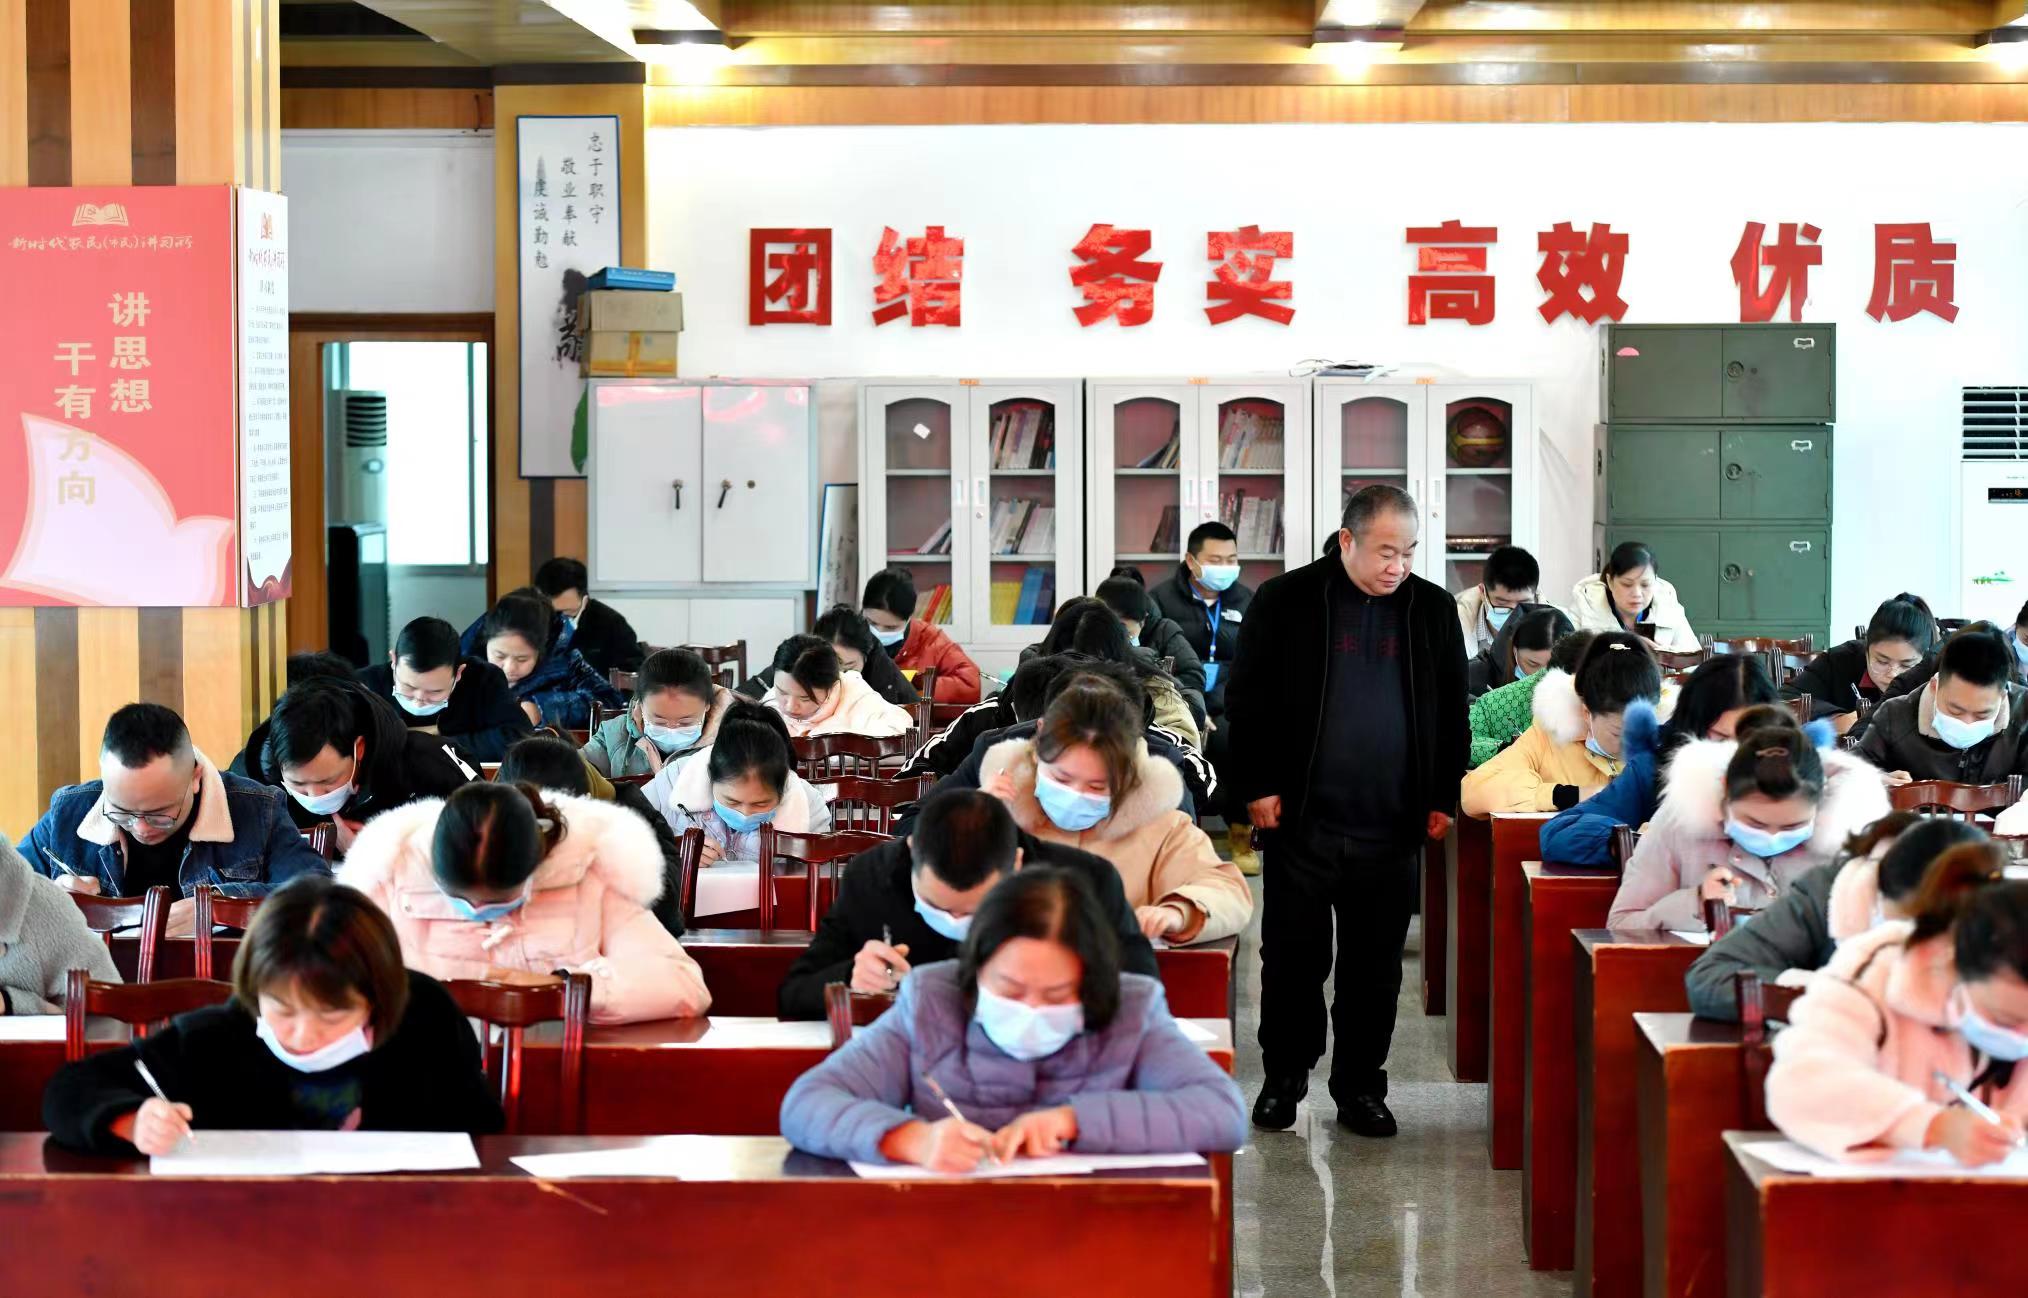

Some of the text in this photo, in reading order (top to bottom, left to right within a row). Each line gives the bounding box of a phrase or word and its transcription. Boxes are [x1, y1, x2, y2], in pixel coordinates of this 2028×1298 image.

[560, 157, 578, 247] 敬业奉献
[587, 132, 605, 224] 忠于职守
[749, 219, 1960, 327] 团结 务实 高效 优质
[108, 291, 152, 413] 讲思想
[54, 342, 96, 505] 干有方向
